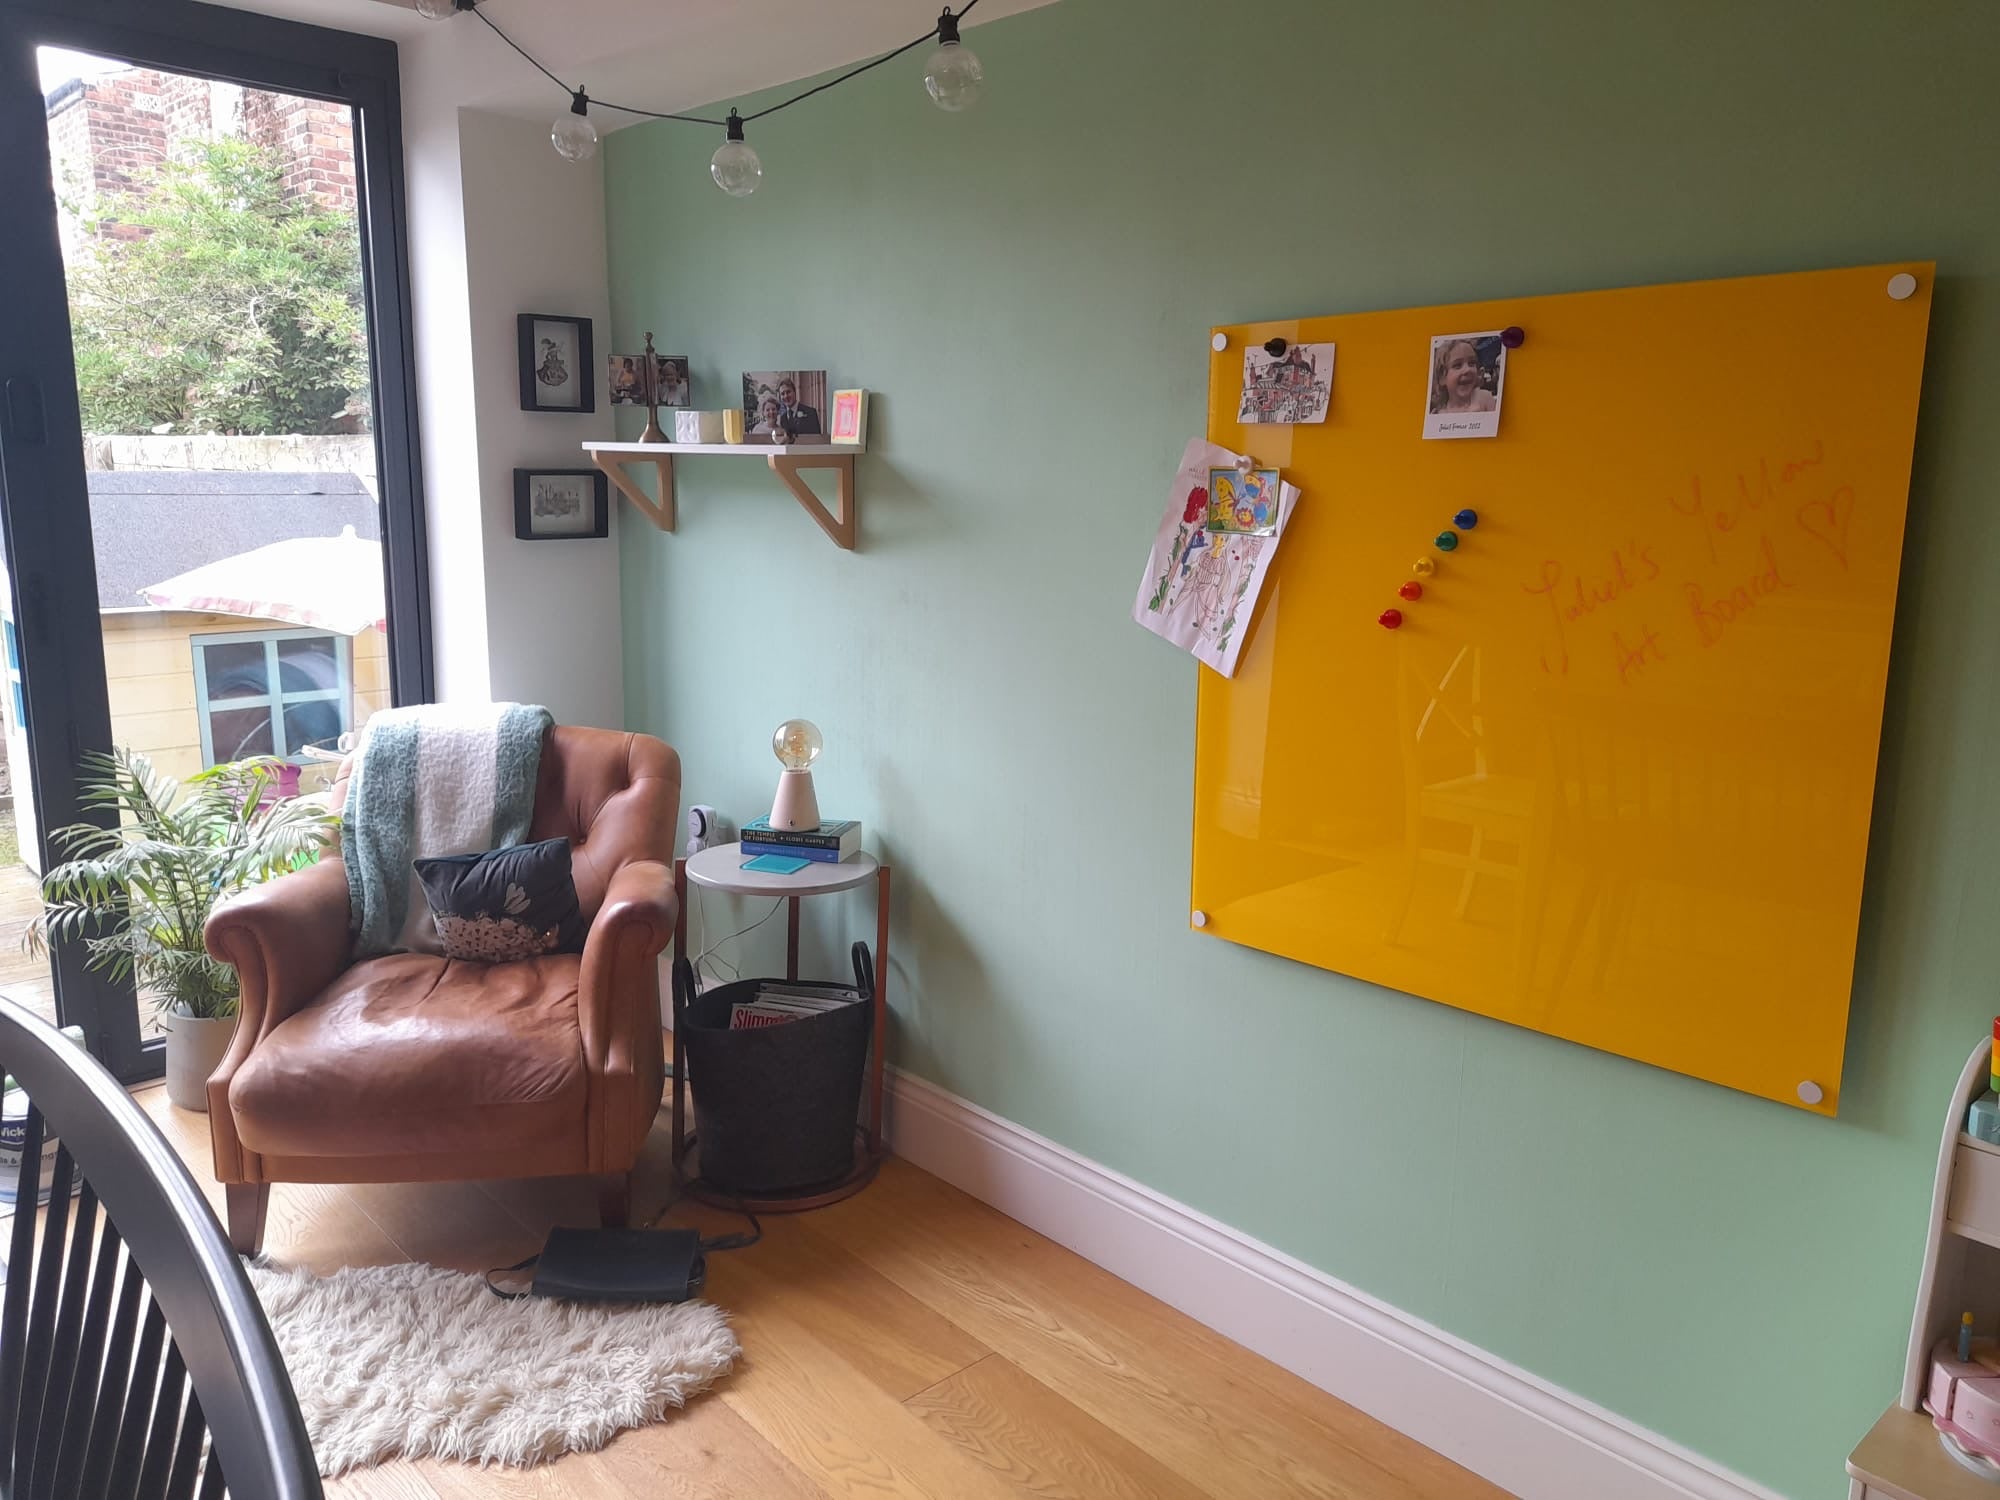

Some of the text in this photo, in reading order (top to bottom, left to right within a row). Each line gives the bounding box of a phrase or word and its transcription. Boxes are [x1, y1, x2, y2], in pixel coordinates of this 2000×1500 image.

[1667, 438, 1825, 565] Yellow
[1611, 534, 1798, 687] Art Board
